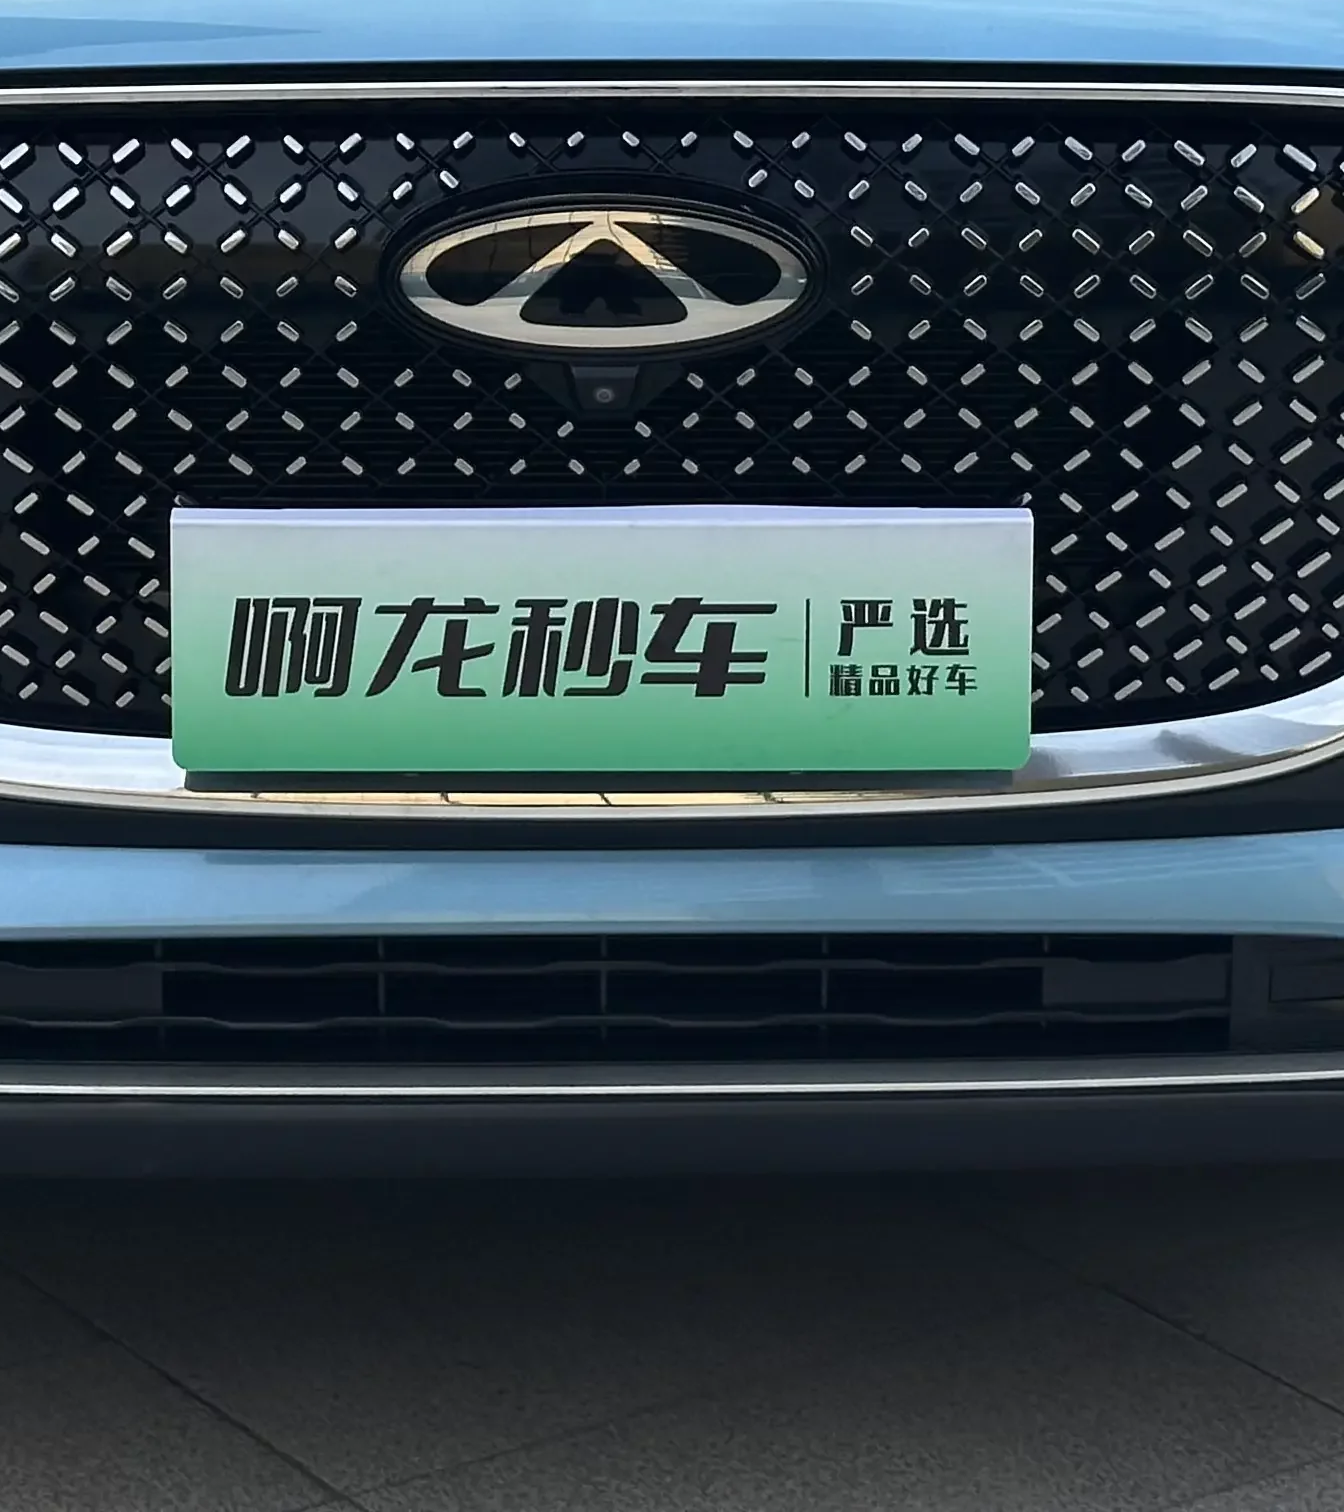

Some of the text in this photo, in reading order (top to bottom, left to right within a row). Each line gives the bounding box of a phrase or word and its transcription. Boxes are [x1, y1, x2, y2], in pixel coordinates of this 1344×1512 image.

[223, 596, 778, 699] 啊龙秒车
[839, 597, 971, 657] 严选
[828, 662, 978, 698] 精品好车
